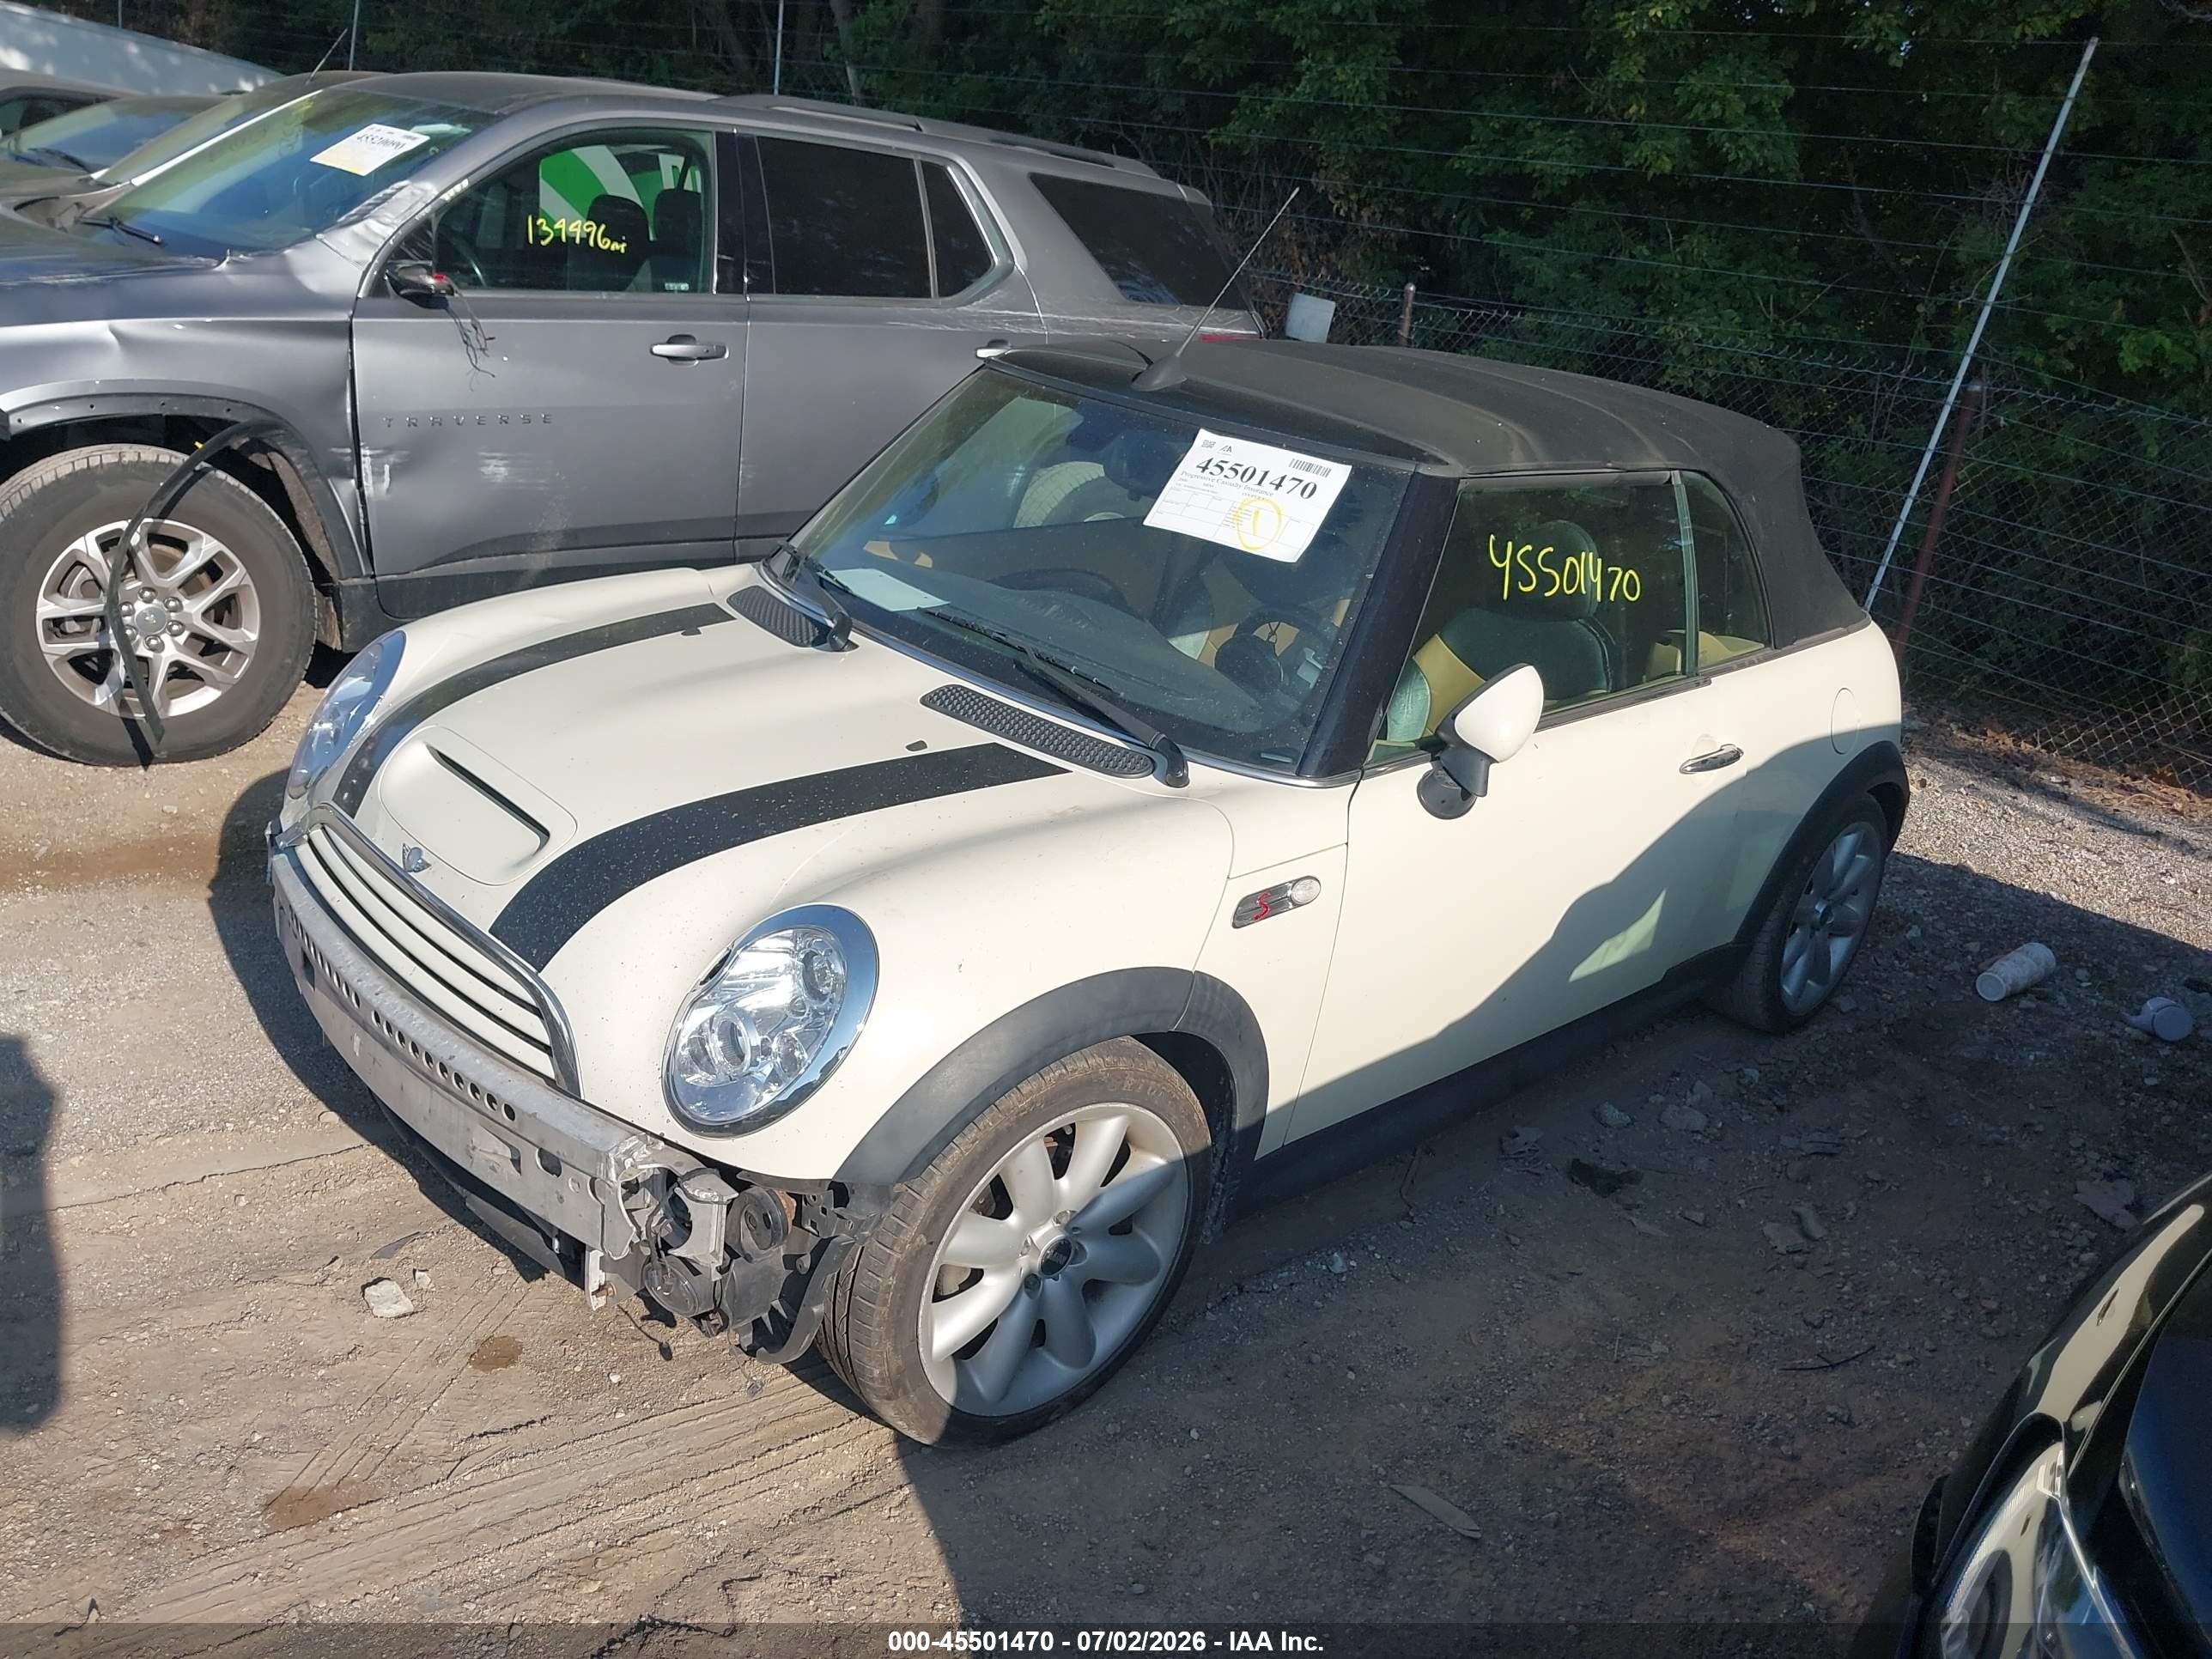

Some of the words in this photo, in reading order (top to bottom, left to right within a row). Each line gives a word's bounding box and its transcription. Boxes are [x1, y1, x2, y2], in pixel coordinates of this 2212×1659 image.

[383, 413, 552, 428] TRAVERSE
[1196, 457, 1318, 500] 45501470
[1253, 892, 1272, 921] S
